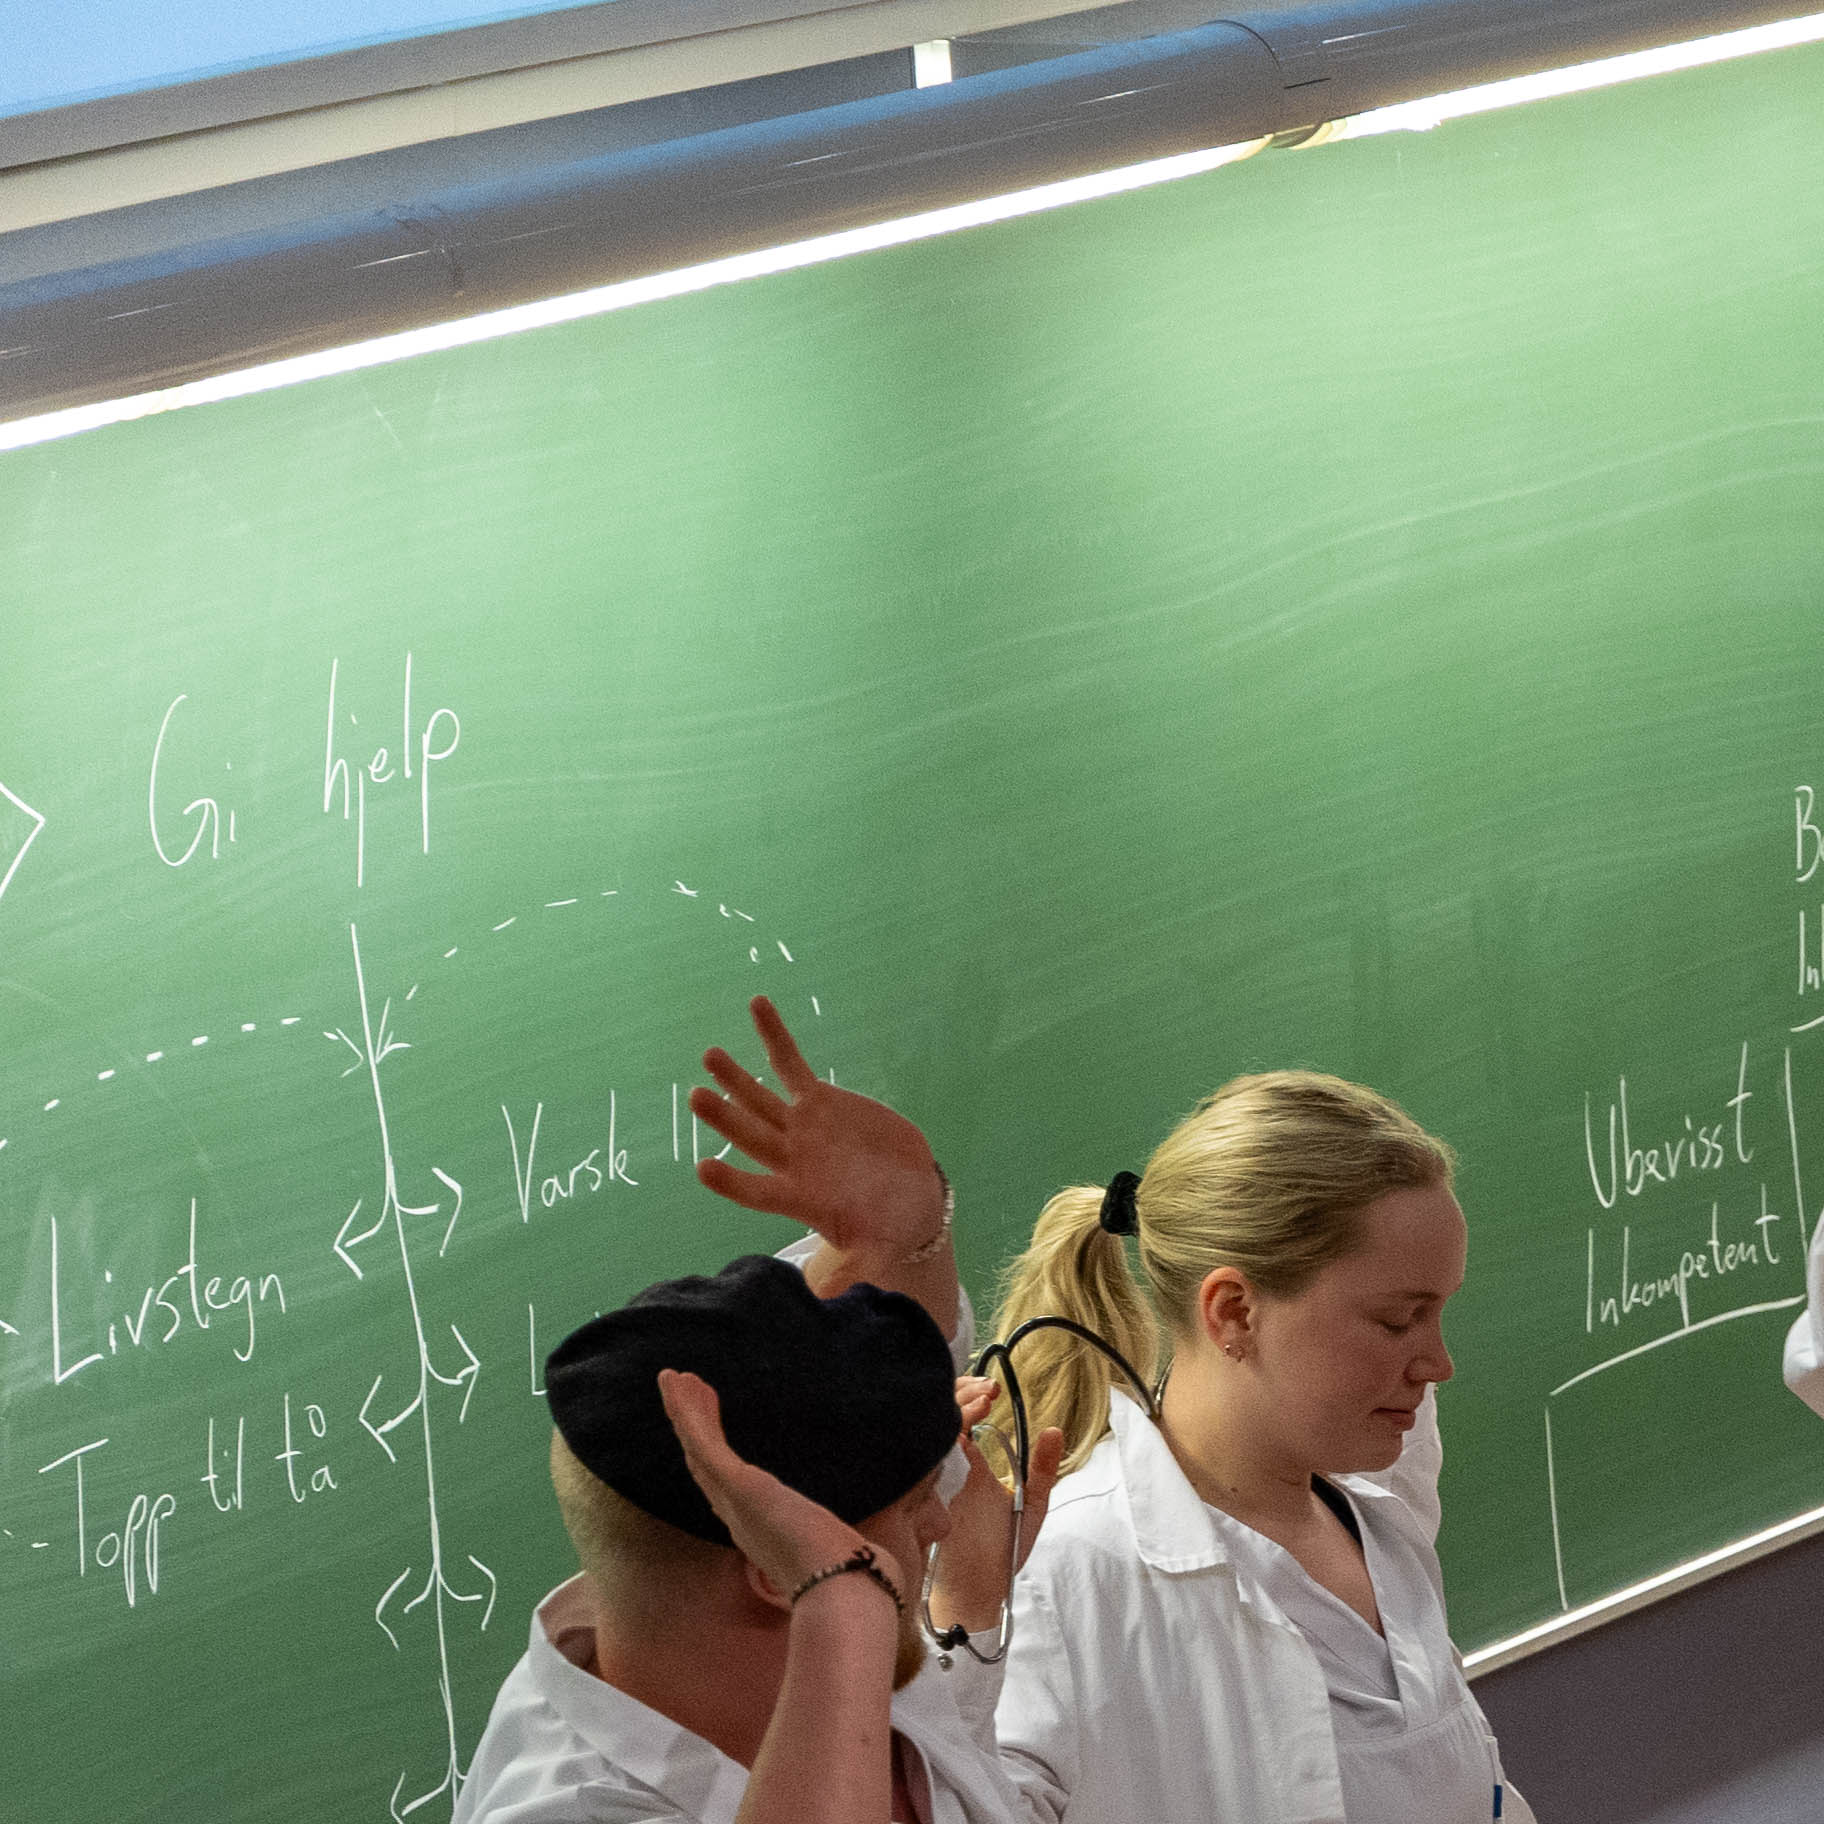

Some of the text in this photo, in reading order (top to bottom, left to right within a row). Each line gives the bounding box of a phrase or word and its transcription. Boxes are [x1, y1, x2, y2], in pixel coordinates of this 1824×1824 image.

[149, 652, 461, 888] Gi hjelp
[1584, 1040, 1755, 1209] Ubevisst
[50, 1196, 287, 1386] Livstegn
[1586, 1183, 1781, 1333] Inkompetent
[39, 1394, 339, 1607] Topp til tå
